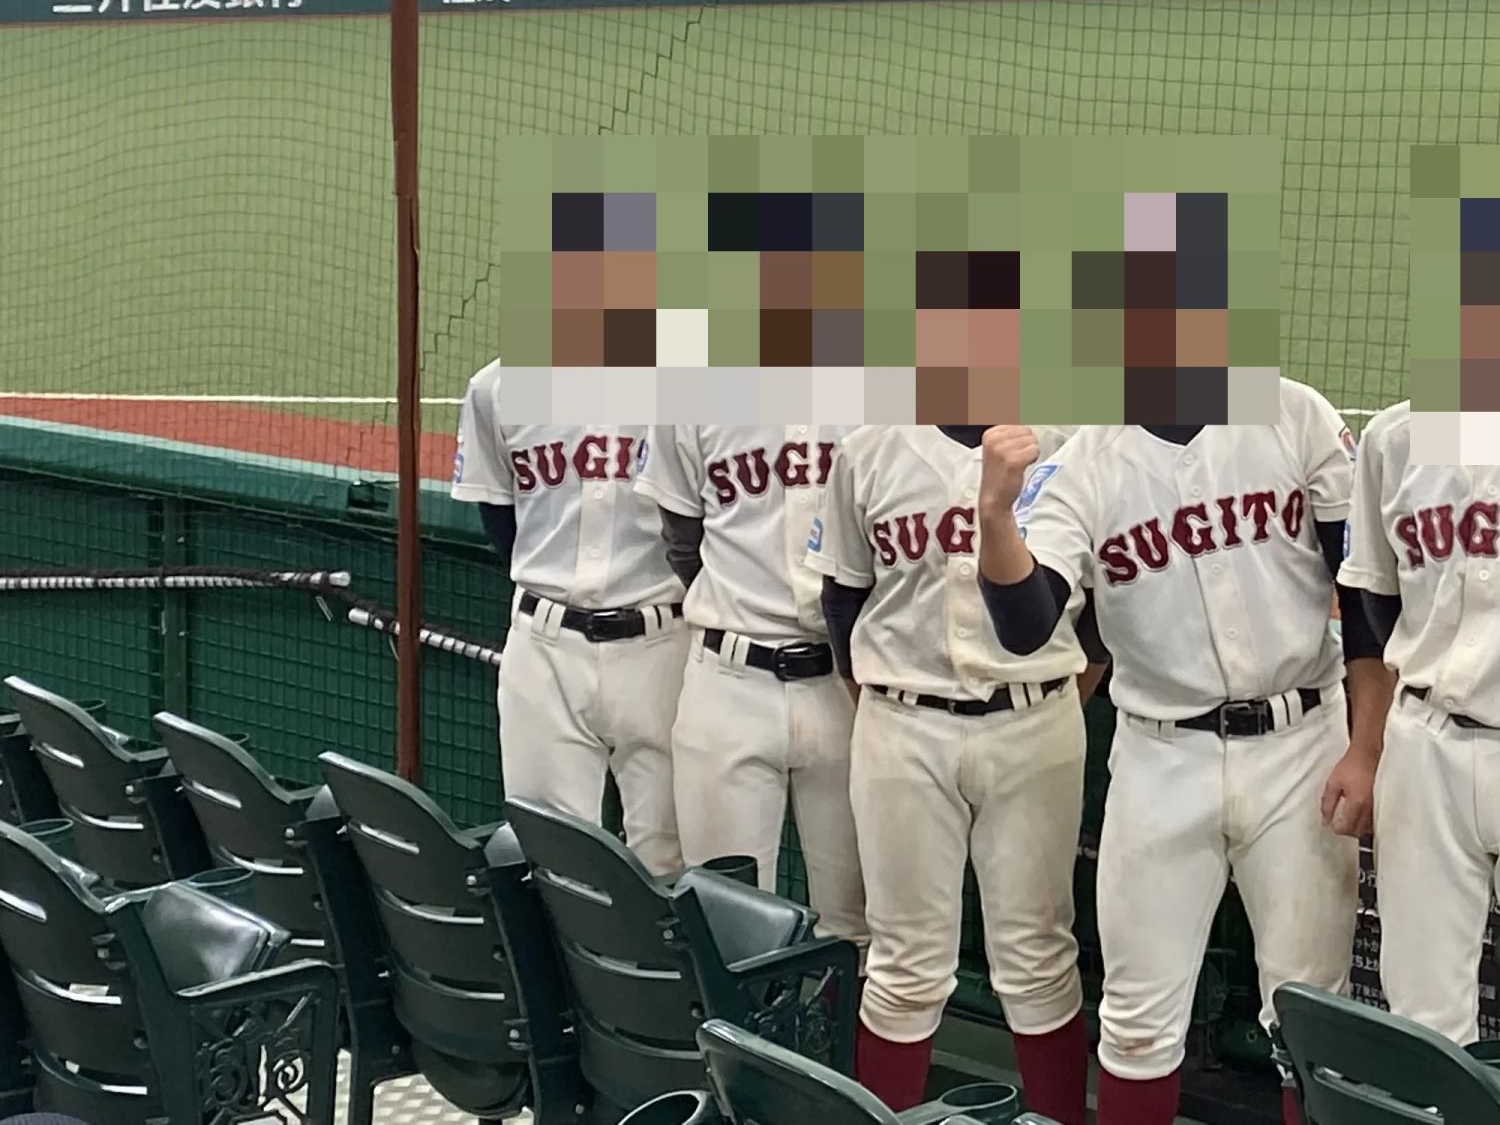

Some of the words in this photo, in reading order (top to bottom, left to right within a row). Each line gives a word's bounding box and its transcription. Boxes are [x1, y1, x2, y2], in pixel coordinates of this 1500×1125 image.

[511, 435, 633, 491] SUGI
[707, 442, 834, 506] SUGI
[873, 506, 976, 567] SUG
[1099, 488, 1302, 586] SUGITO
